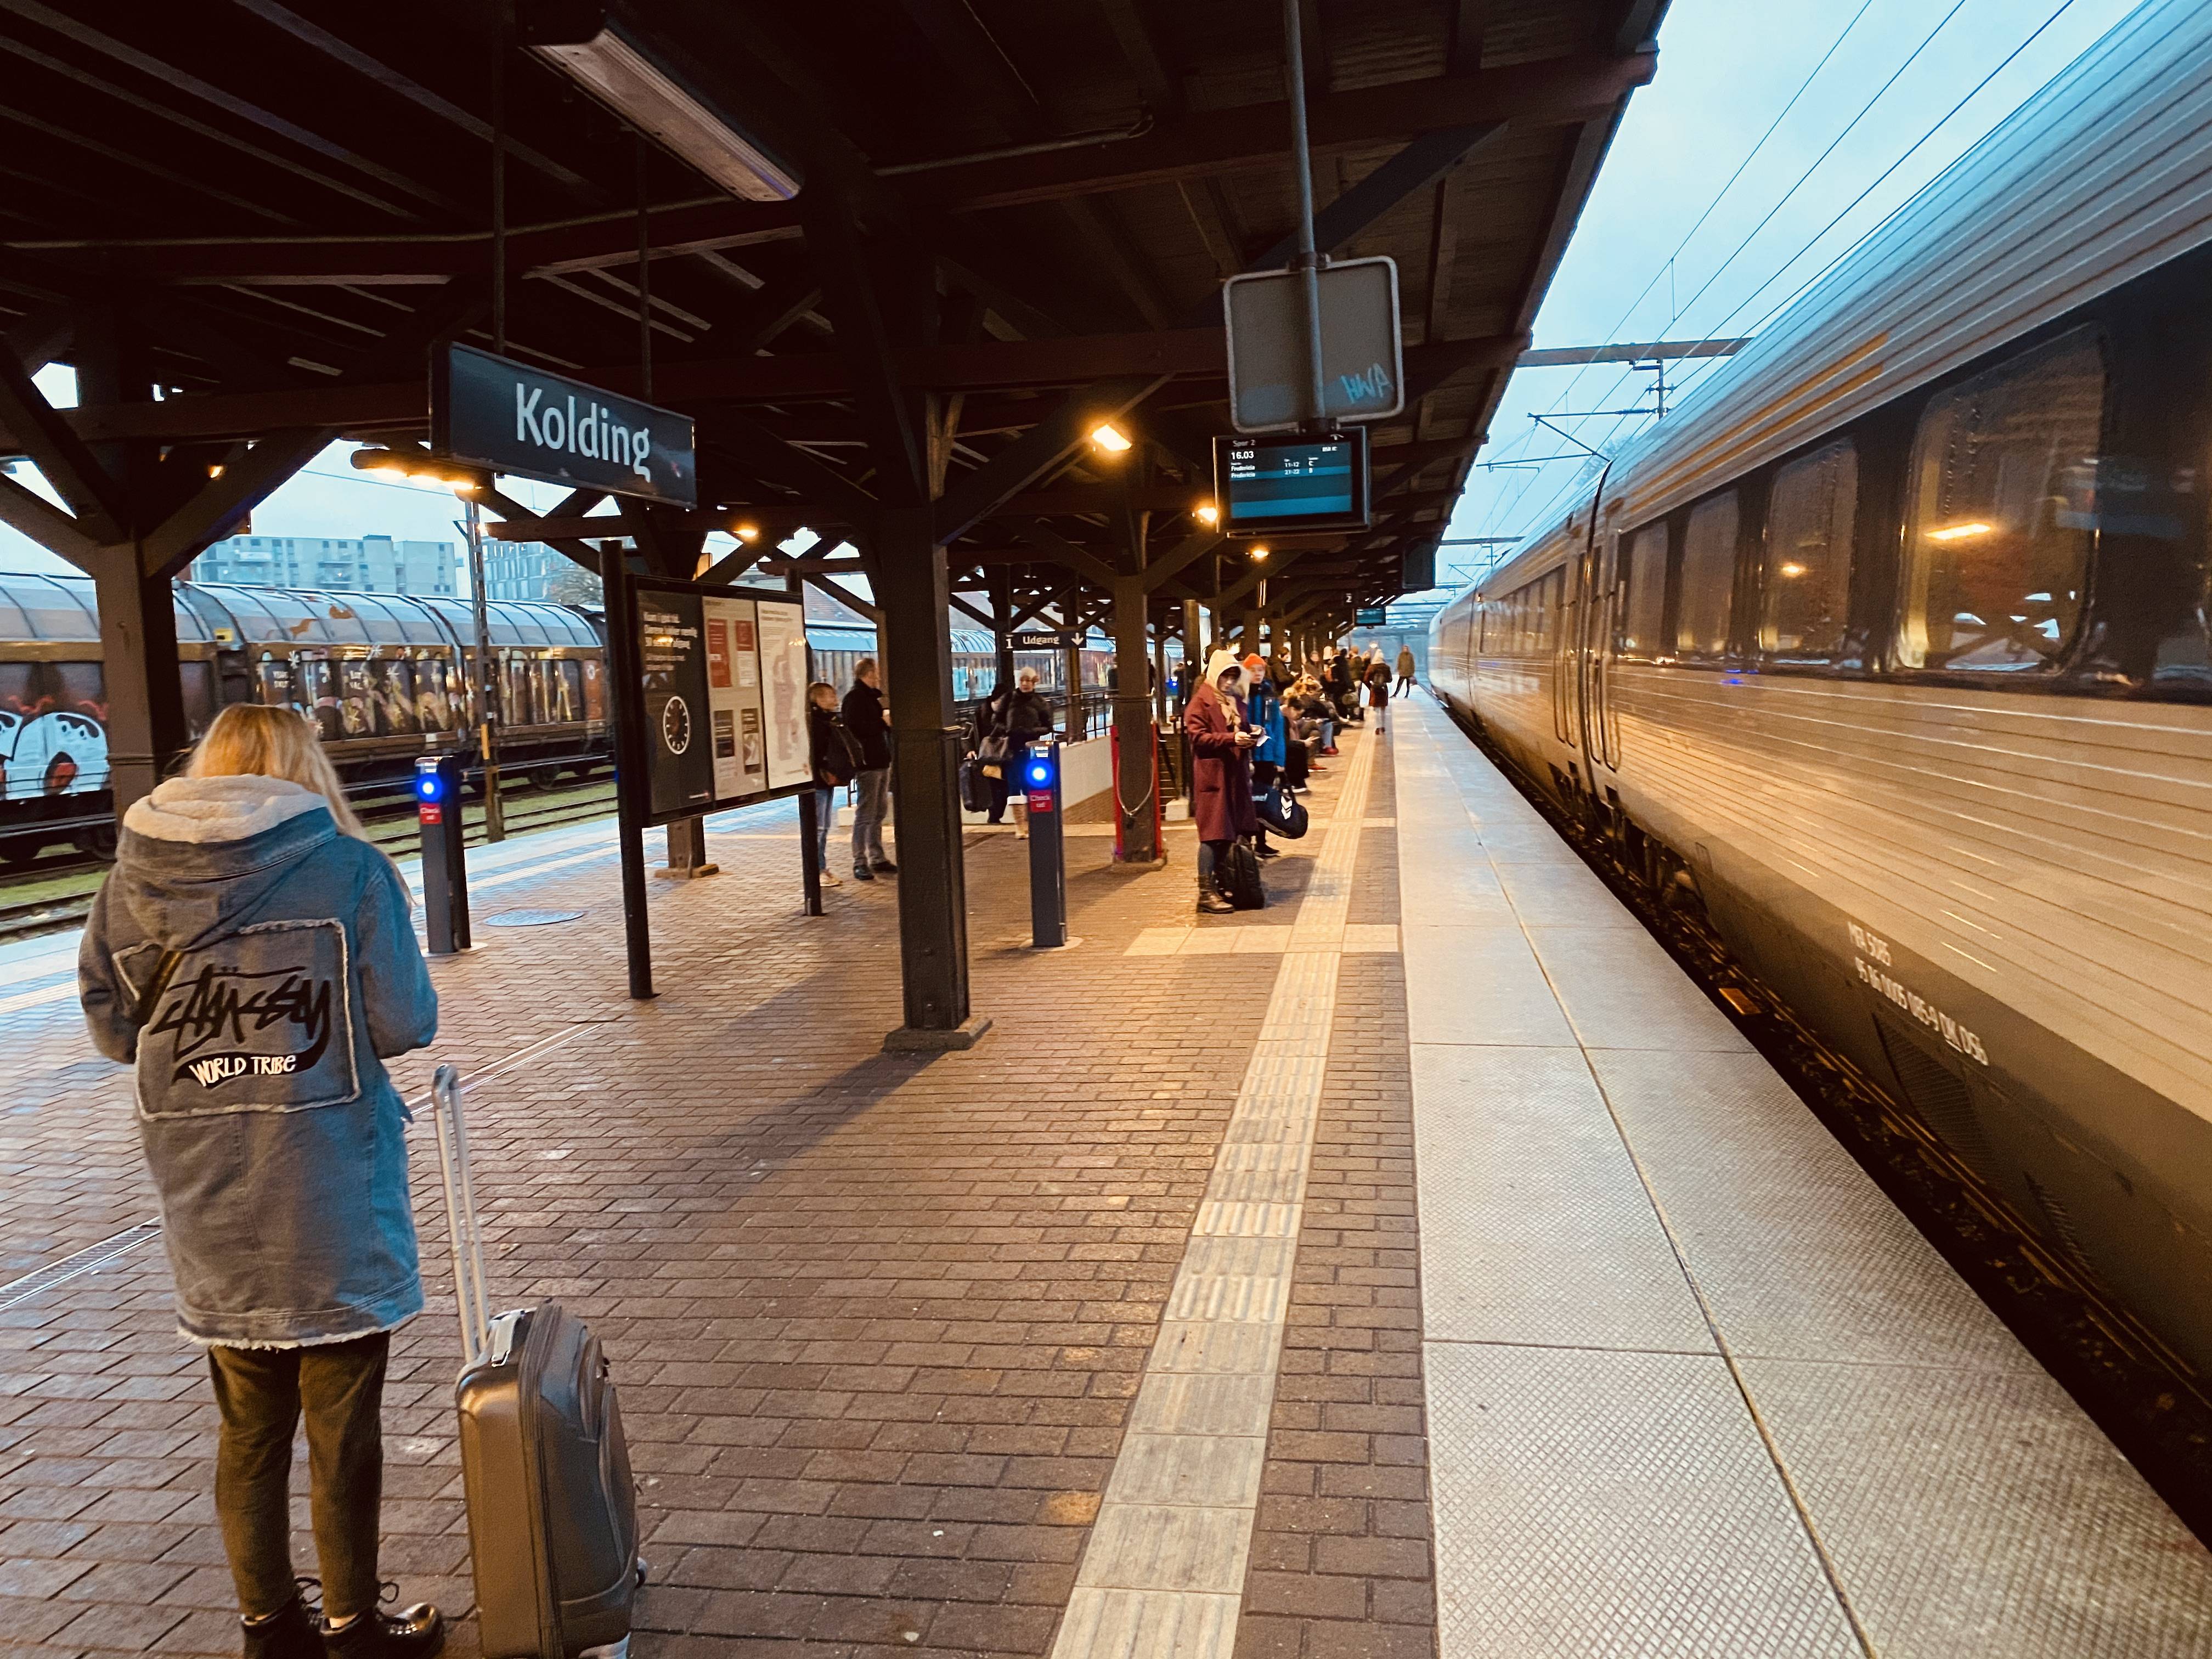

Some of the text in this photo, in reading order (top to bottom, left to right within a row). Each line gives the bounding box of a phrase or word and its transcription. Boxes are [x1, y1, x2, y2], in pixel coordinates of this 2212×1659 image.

[516, 383, 651, 483] Kolding
[1231, 450, 1254, 460] 16.03
[1006, 636, 1059, 649] 1 Udgang
[189, 1054, 297, 1088] WORLD TRIBE
